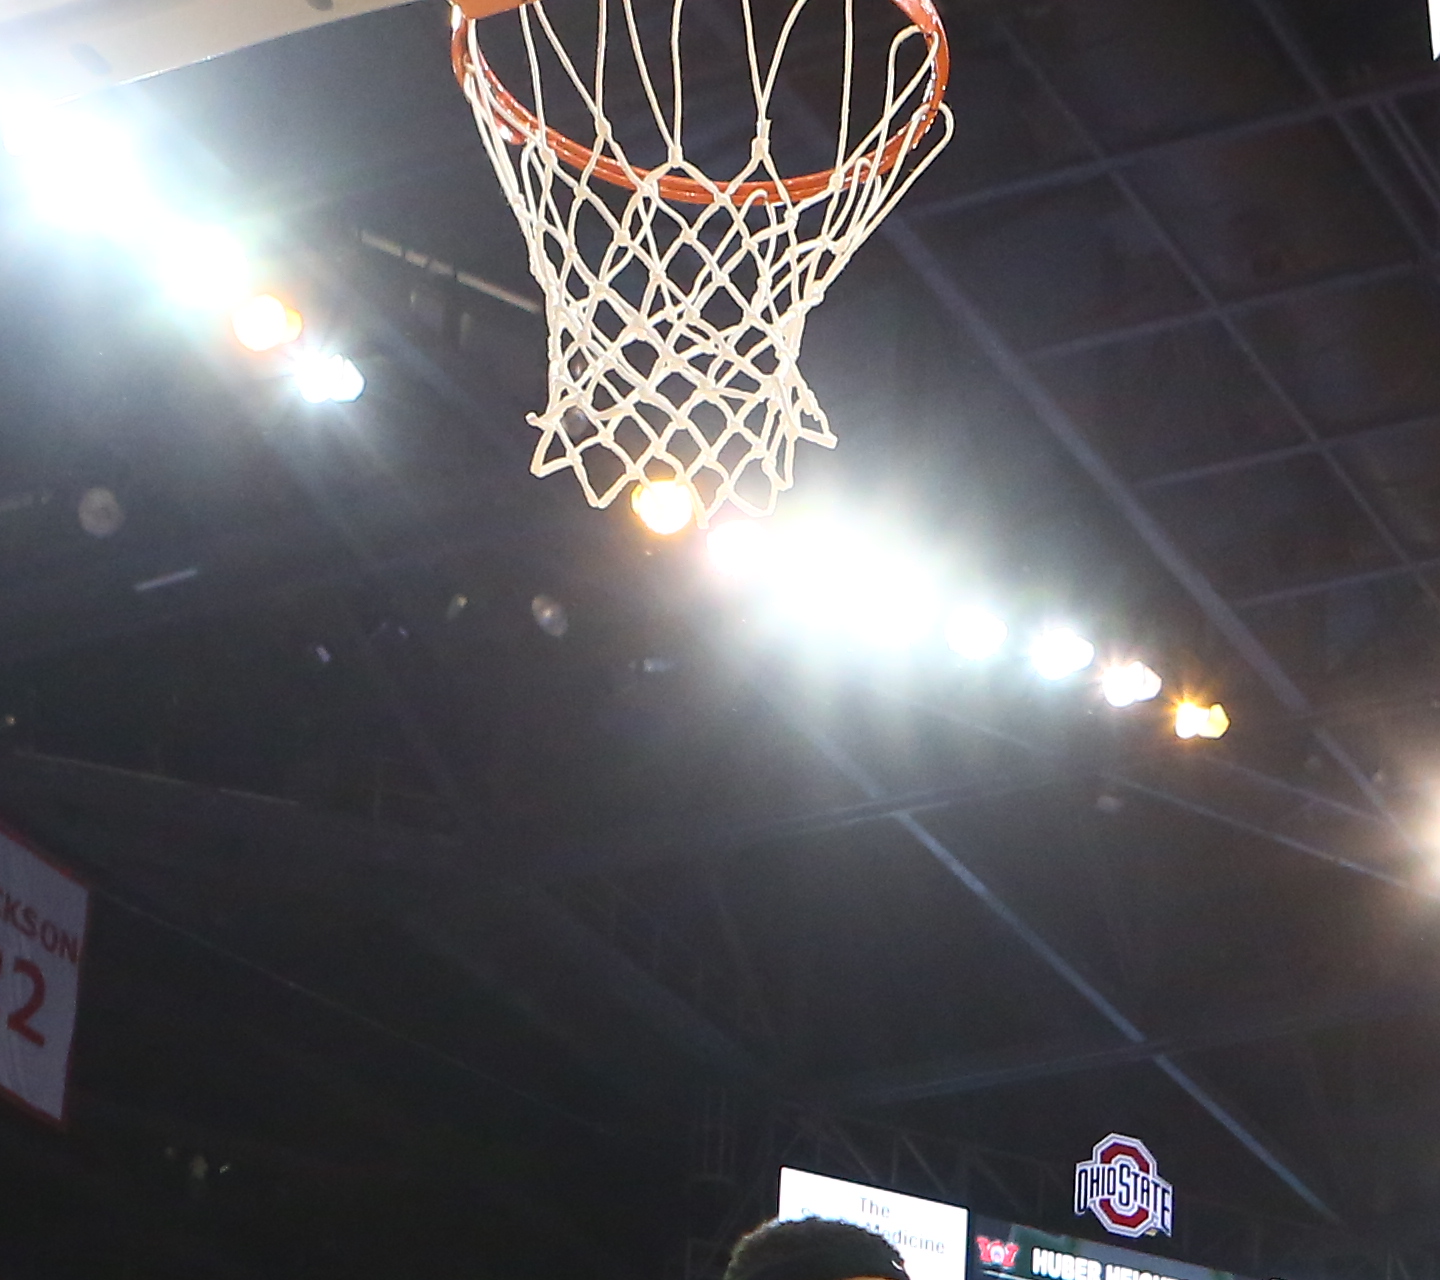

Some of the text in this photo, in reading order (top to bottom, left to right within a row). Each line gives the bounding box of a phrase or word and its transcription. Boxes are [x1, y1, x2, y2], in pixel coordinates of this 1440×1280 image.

[860, 1198, 890, 1219] The
[1078, 1163, 1173, 1237] OHIO STATE
